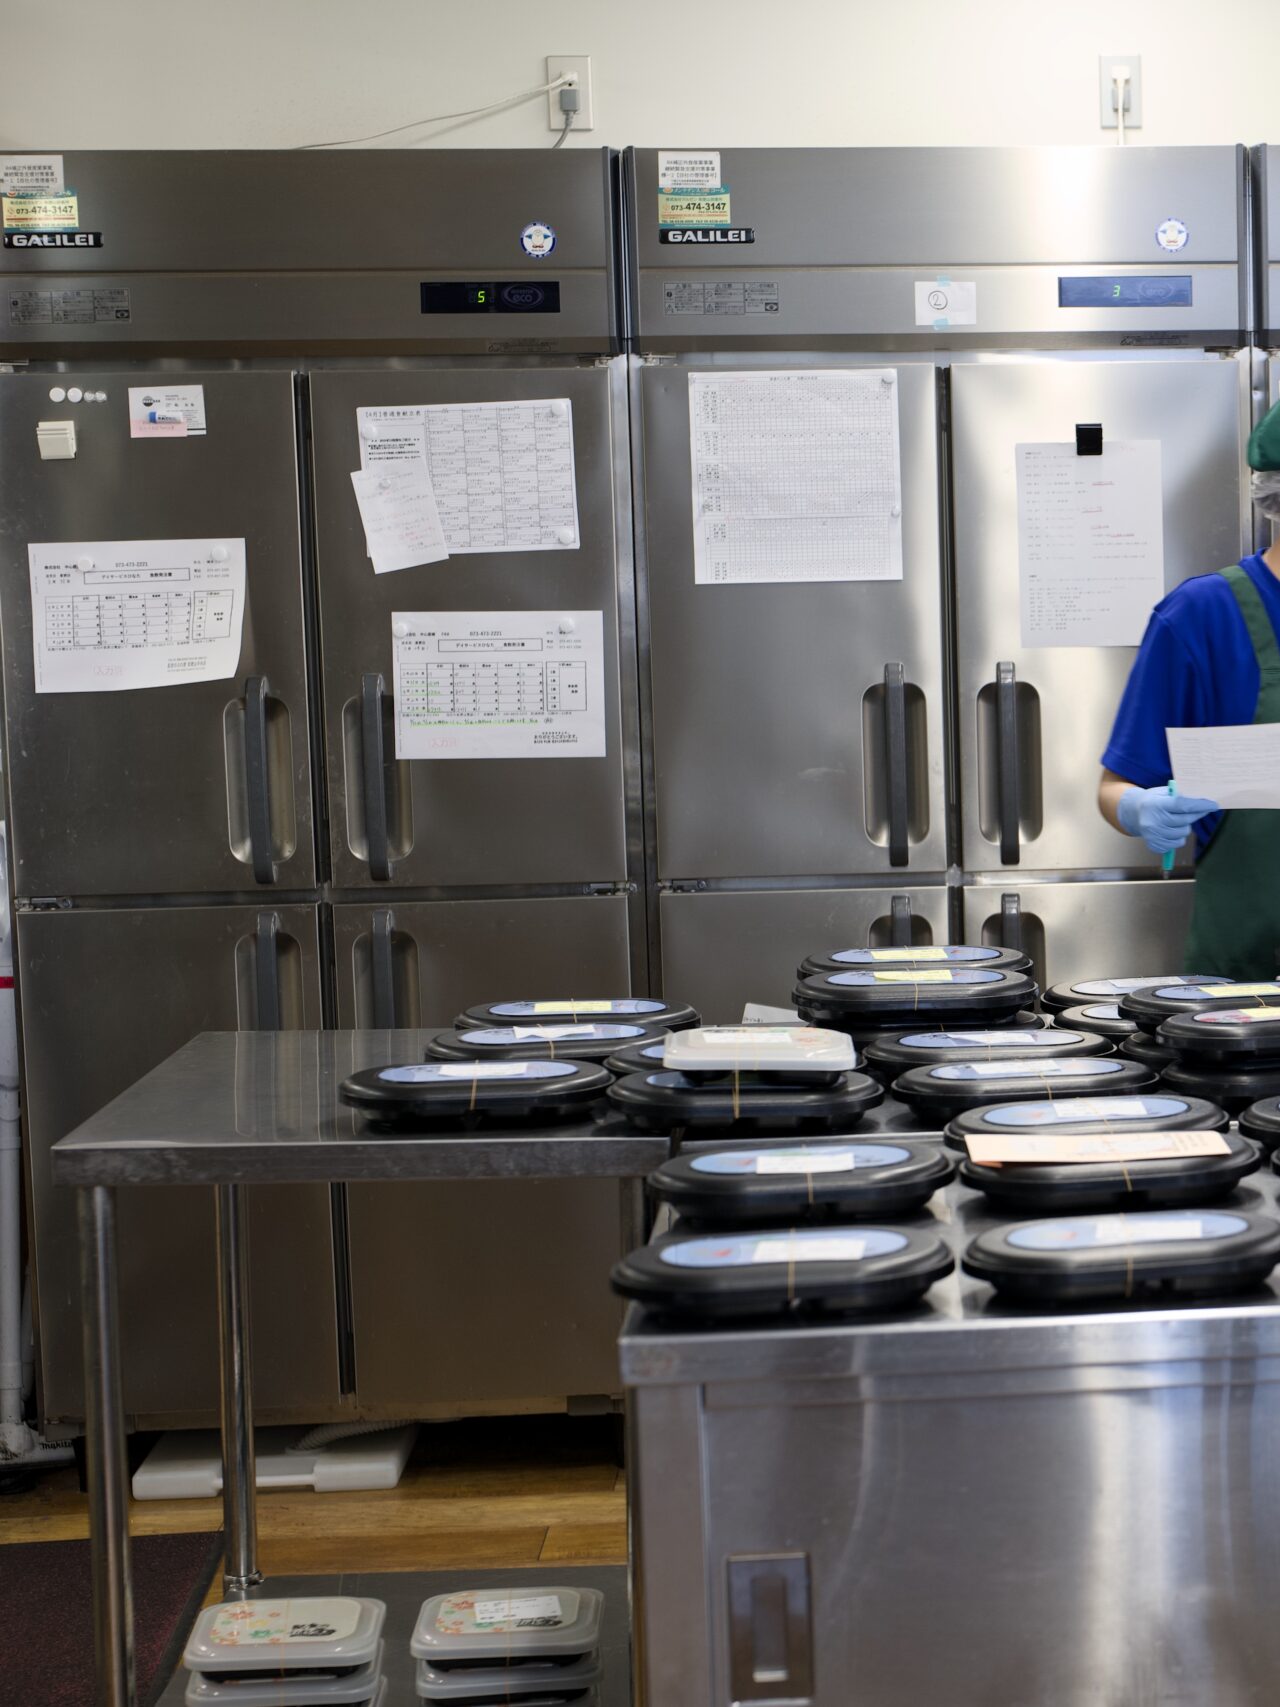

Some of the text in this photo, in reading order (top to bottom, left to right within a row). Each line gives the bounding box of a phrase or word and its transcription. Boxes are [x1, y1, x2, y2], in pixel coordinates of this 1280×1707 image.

[16, 206, 74, 214] 073-474-3147
[671, 203, 727, 211] 073-474-3147
[12, 234, 94, 246] GALILEI
[668, 230, 746, 242] GALILEI
[477, 291, 486, 303] 5
[1112, 285, 1120, 297] 3
[512, 294, 533, 302] eco
